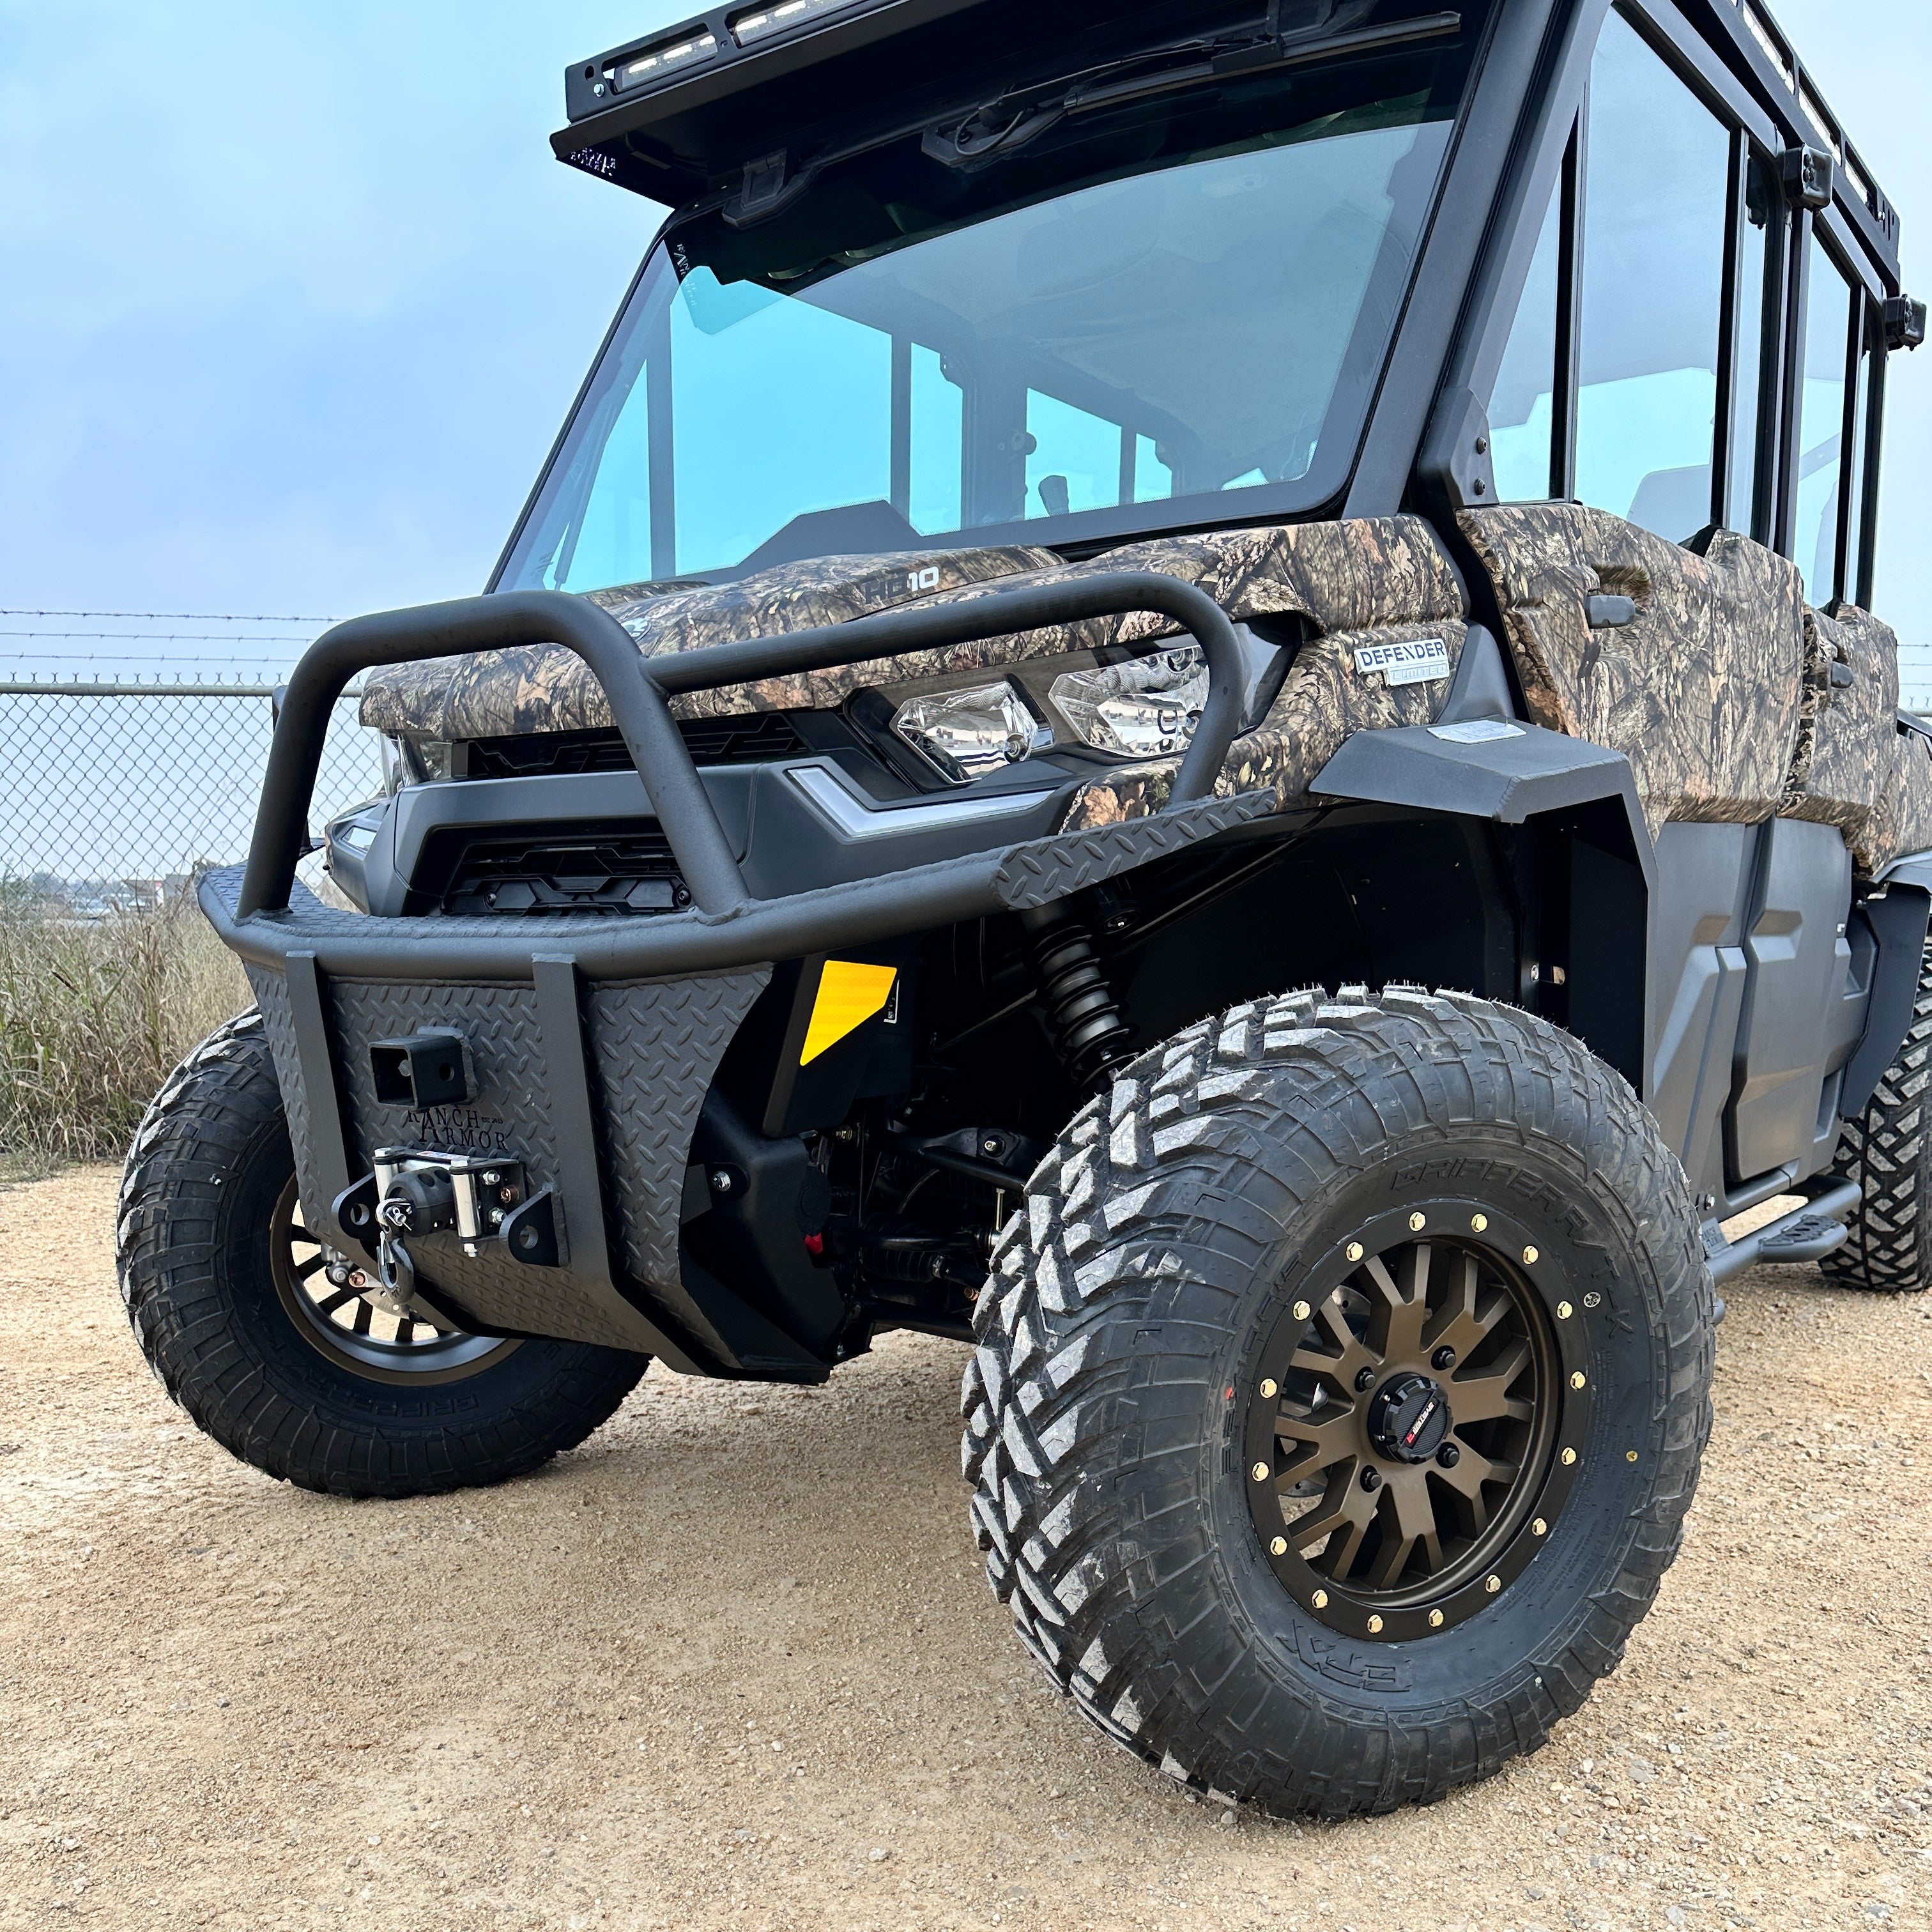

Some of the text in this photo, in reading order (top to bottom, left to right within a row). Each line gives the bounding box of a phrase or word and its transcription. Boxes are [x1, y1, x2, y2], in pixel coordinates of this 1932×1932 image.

[864, 566, 939, 604] HD10
[1360, 641, 1446, 667] DEFENDER
[1392, 666, 1447, 680] LIMITED
[1390, 1156, 1566, 1213] GRIPPER
